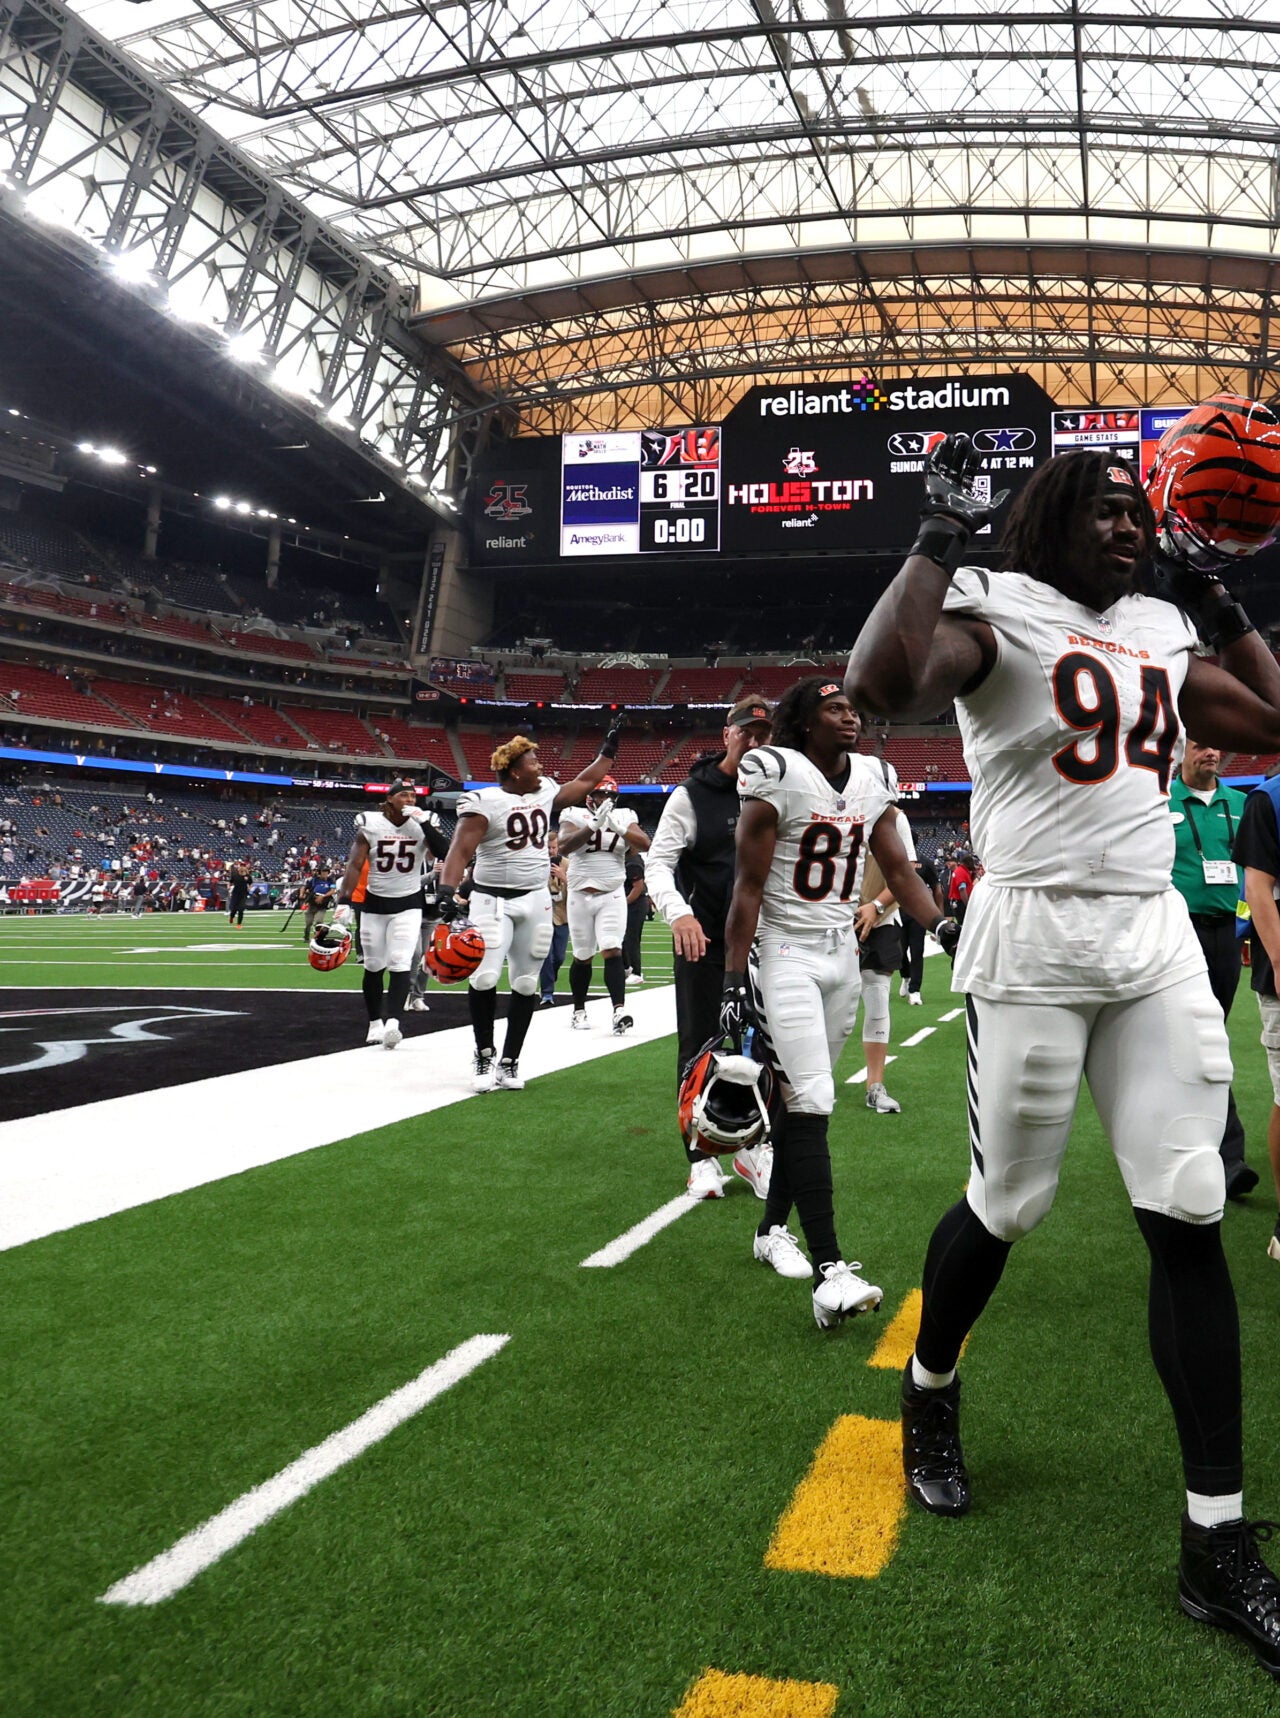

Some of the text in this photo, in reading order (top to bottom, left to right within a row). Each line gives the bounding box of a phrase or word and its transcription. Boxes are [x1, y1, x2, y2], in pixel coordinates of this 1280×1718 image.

[761, 382, 1009, 416] reliant stadium
[1075, 433, 1119, 442] GAME STATS
[990, 458, 1002, 469] AT
[1004, 457, 1017, 468] 12
[1019, 456, 1034, 468] PM
[566, 486, 634, 502] Methodist
[653, 473, 668, 499] 6
[685, 471, 715, 498] 20
[728, 480, 874, 505] HOUSTON
[751, 503, 851, 513] FOREVER H-TOWN
[486, 536, 527, 549] reliant
[570, 533, 626, 546] AmegyBank
[654, 518, 705, 543] 0:00
[1067, 634, 1151, 660] BENGALS
[1051, 650, 1180, 797] 94
[505, 808, 548, 851] 90
[810, 812, 866, 823] BENGALS
[377, 840, 418, 873] 55
[793, 822, 865, 903] 81
